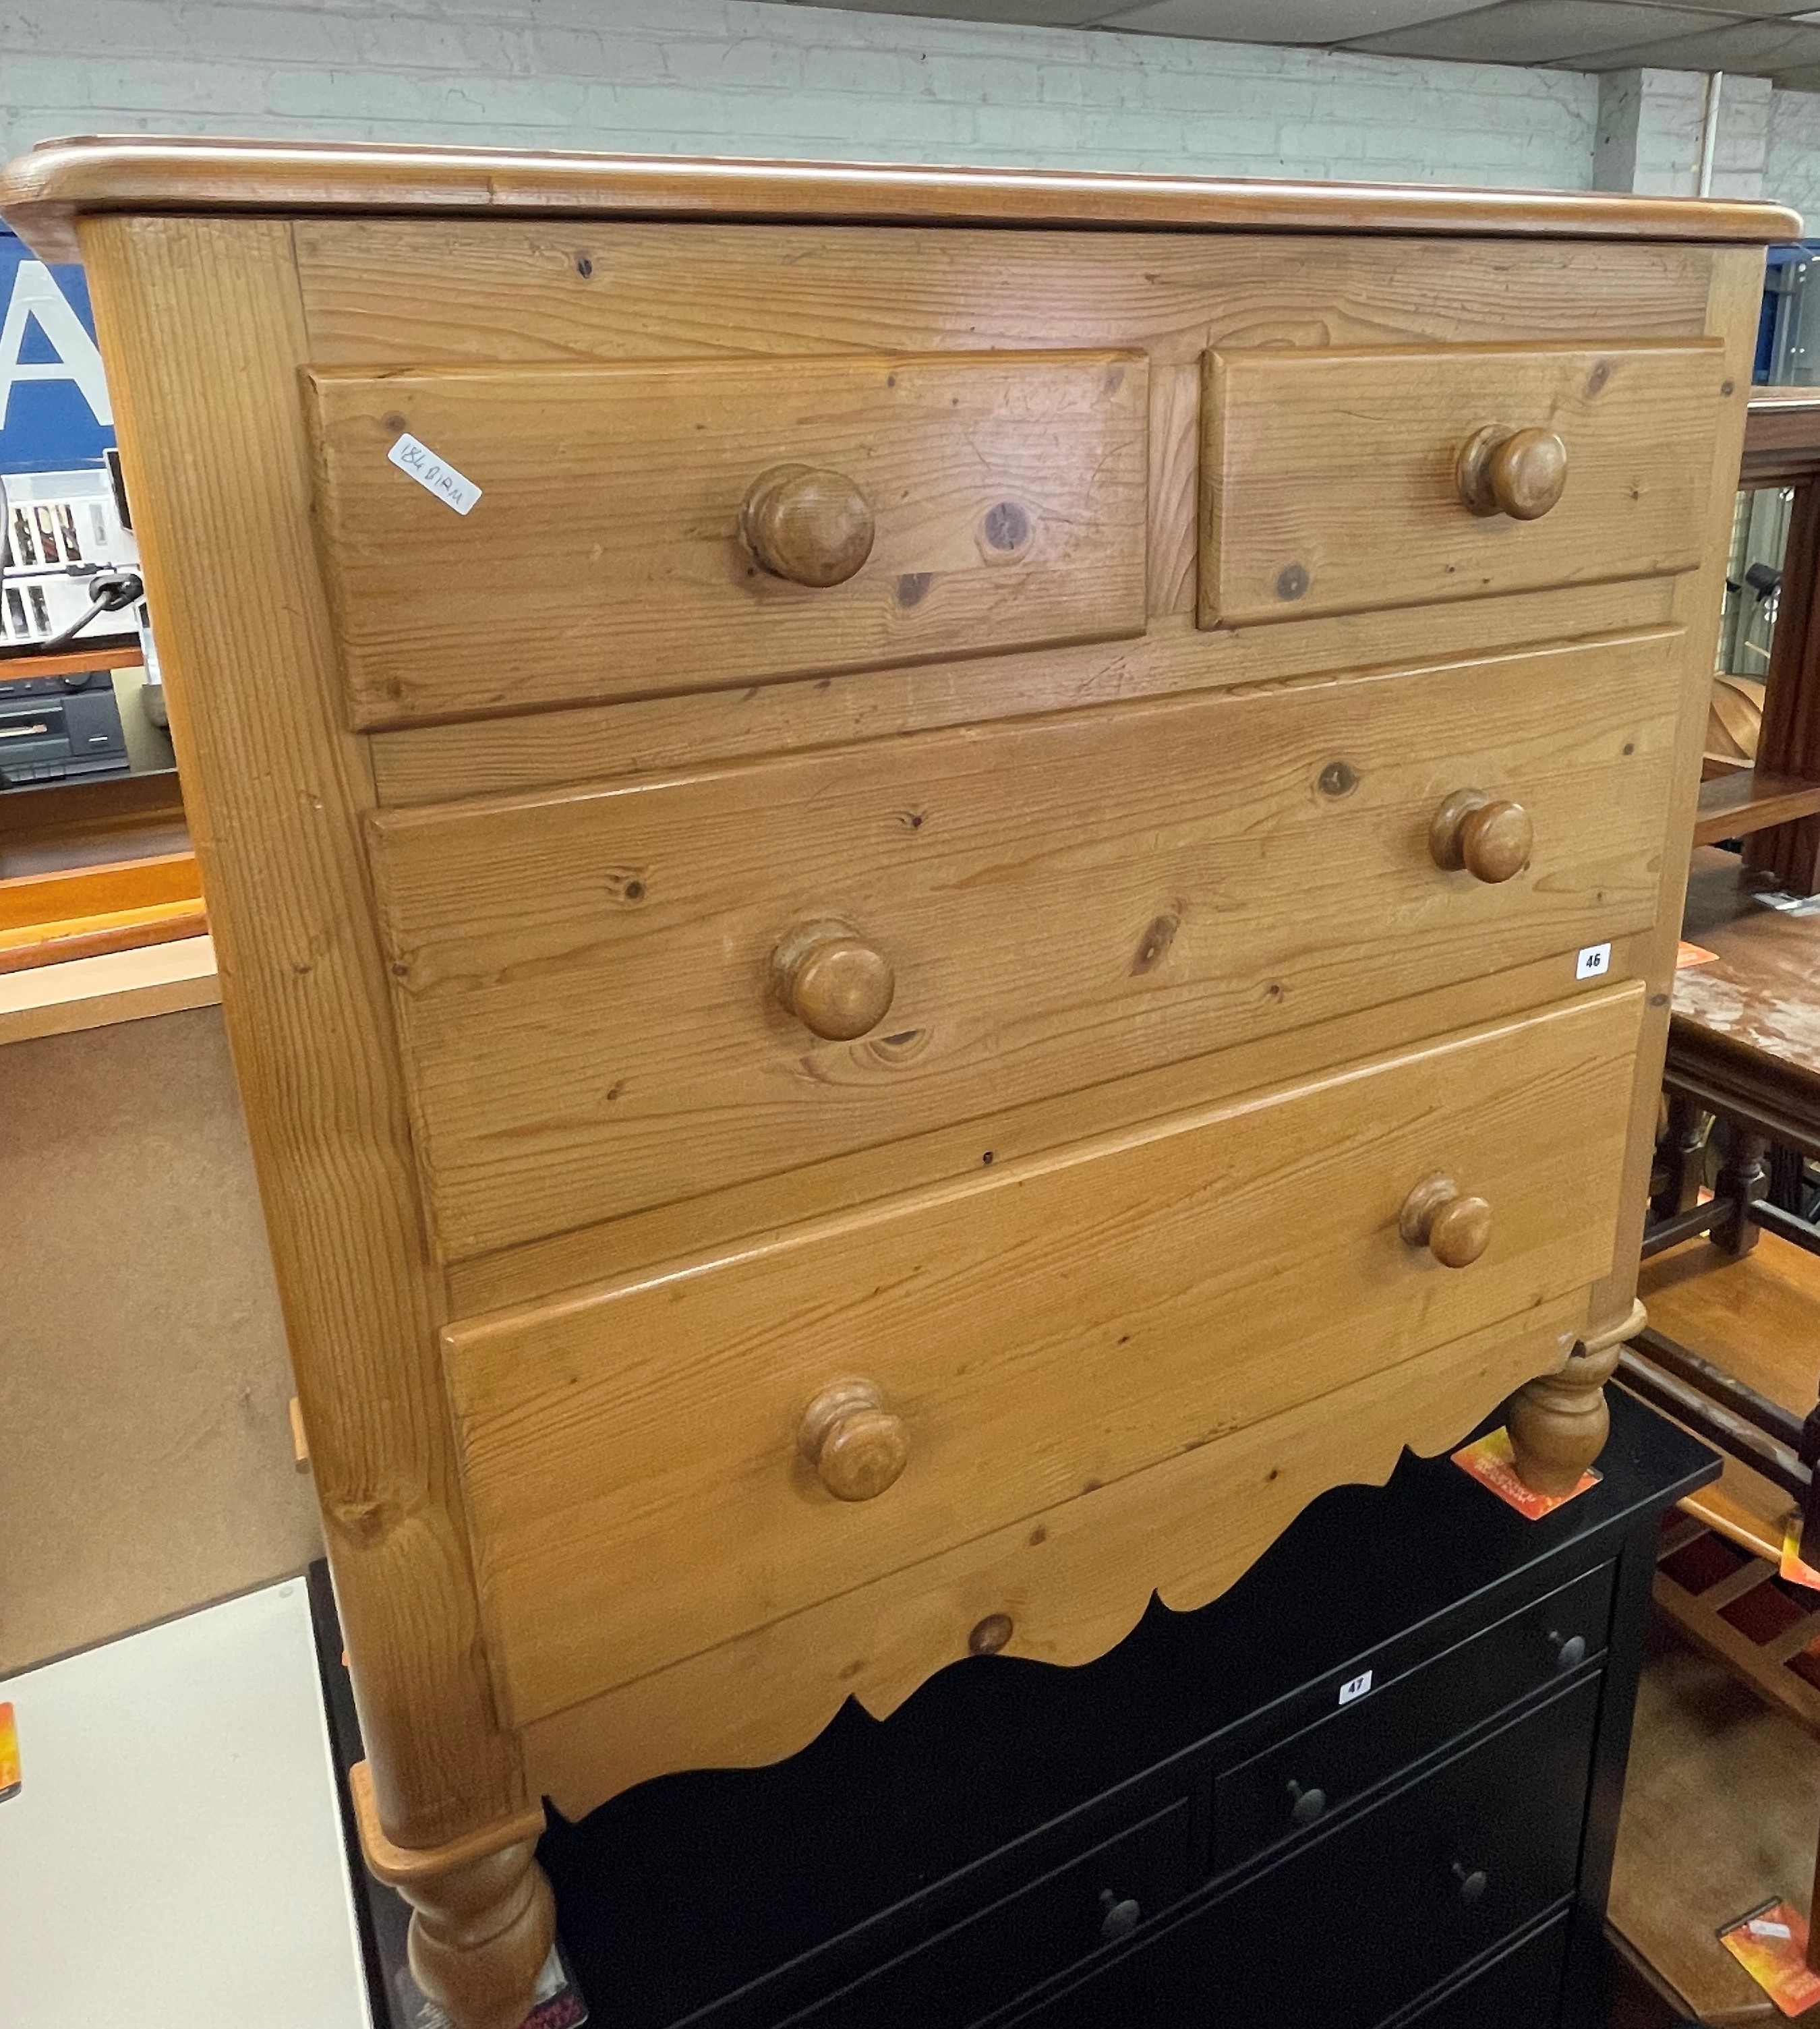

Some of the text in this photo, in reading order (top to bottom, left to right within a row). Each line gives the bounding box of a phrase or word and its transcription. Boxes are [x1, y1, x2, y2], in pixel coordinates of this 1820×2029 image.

[0, 259, 113, 430] A
[1586, 953, 1601, 968] 46
[1348, 1678, 1365, 1693] 47
